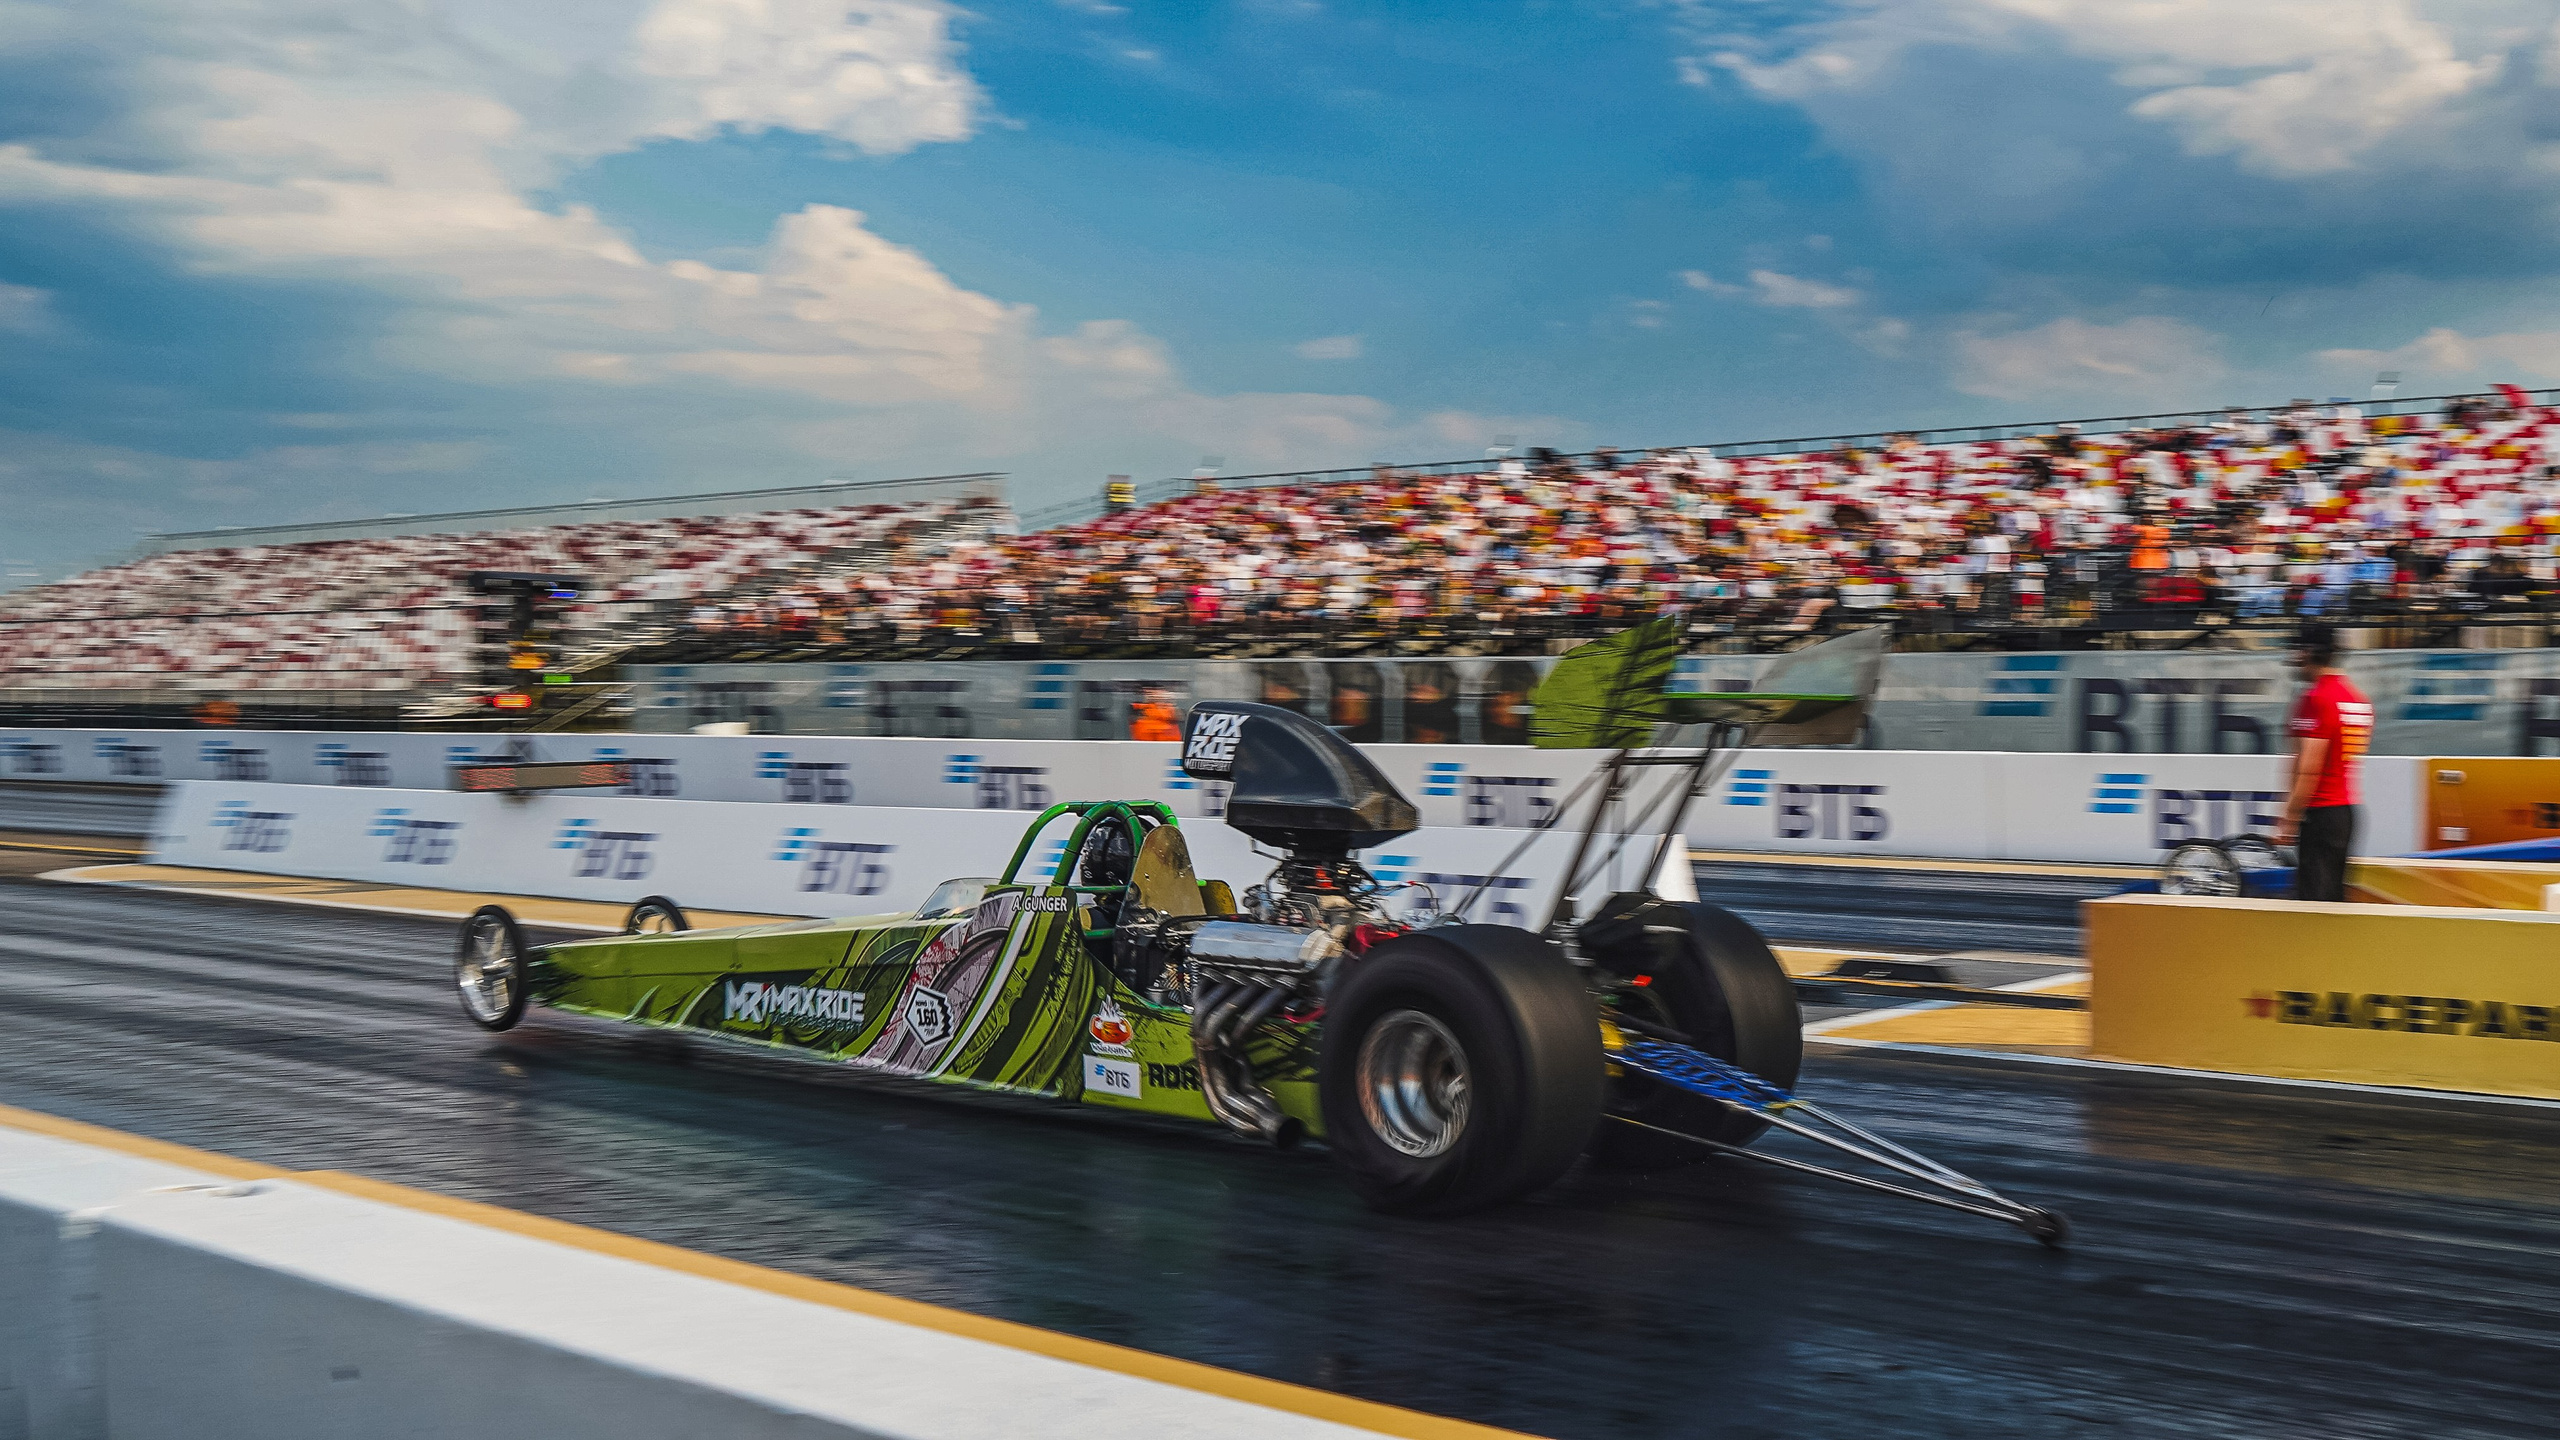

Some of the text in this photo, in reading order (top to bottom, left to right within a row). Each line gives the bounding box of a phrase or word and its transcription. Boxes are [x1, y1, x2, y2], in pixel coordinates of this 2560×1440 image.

[1193, 713, 1251, 737] MAX
[1185, 735, 1241, 760] RIDE
[1774, 784, 1892, 841] ВТБ
[1024, 896, 1068, 912] GUNGER
[917, 1008, 938, 1027] 160
[1105, 1069, 1131, 1090] ВТБ
